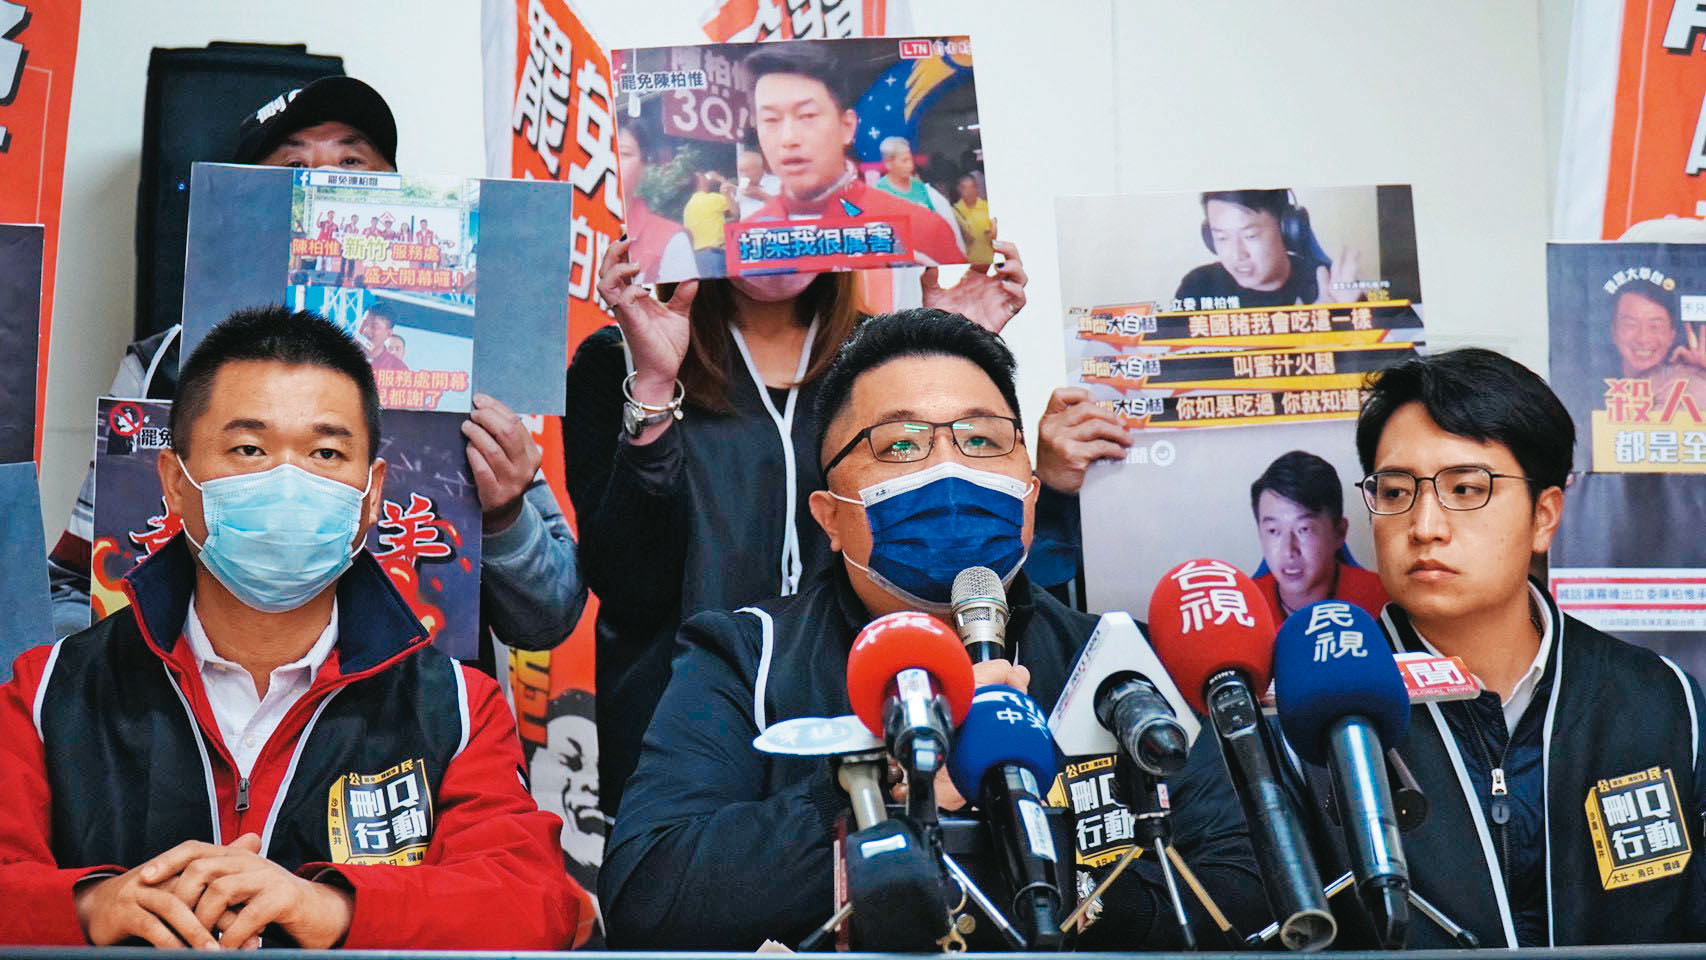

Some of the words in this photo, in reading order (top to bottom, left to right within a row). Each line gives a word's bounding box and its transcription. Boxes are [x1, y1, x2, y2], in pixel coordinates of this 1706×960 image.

[904, 43, 928, 55] LTN
[621, 72, 704, 90] 罷免陳柏惟
[672, 88, 749, 139] 3Q!
[327, 174, 379, 186] 罷免陳柏惟
[293, 239, 340, 256] 陳柏惟
[343, 236, 389, 260] 新竹
[392, 244, 439, 261] 服務處
[738, 226, 894, 260] 打架我很厲害
[1172, 298, 1196, 312] 立委
[1200, 296, 1240, 310] 陳柏惟
[1189, 308, 1373, 337] 美國豬我會吃這一樣
[1233, 352, 1336, 378] 叫蜜汁火腿
[373, 370, 465, 389] 服務處開幕
[1176, 398, 1276, 419] 你如果吃過
[1606, 379, 1702, 423] 殺人
[1171, 561, 1255, 634] 台視
[1305, 603, 1368, 663] 民視
[1209, 670, 1235, 685] SONY
[1401, 661, 1466, 688] 聞
[354, 807, 427, 849] 行動
[1076, 808, 1136, 850] 行動
[1612, 819, 1681, 860] 行動
